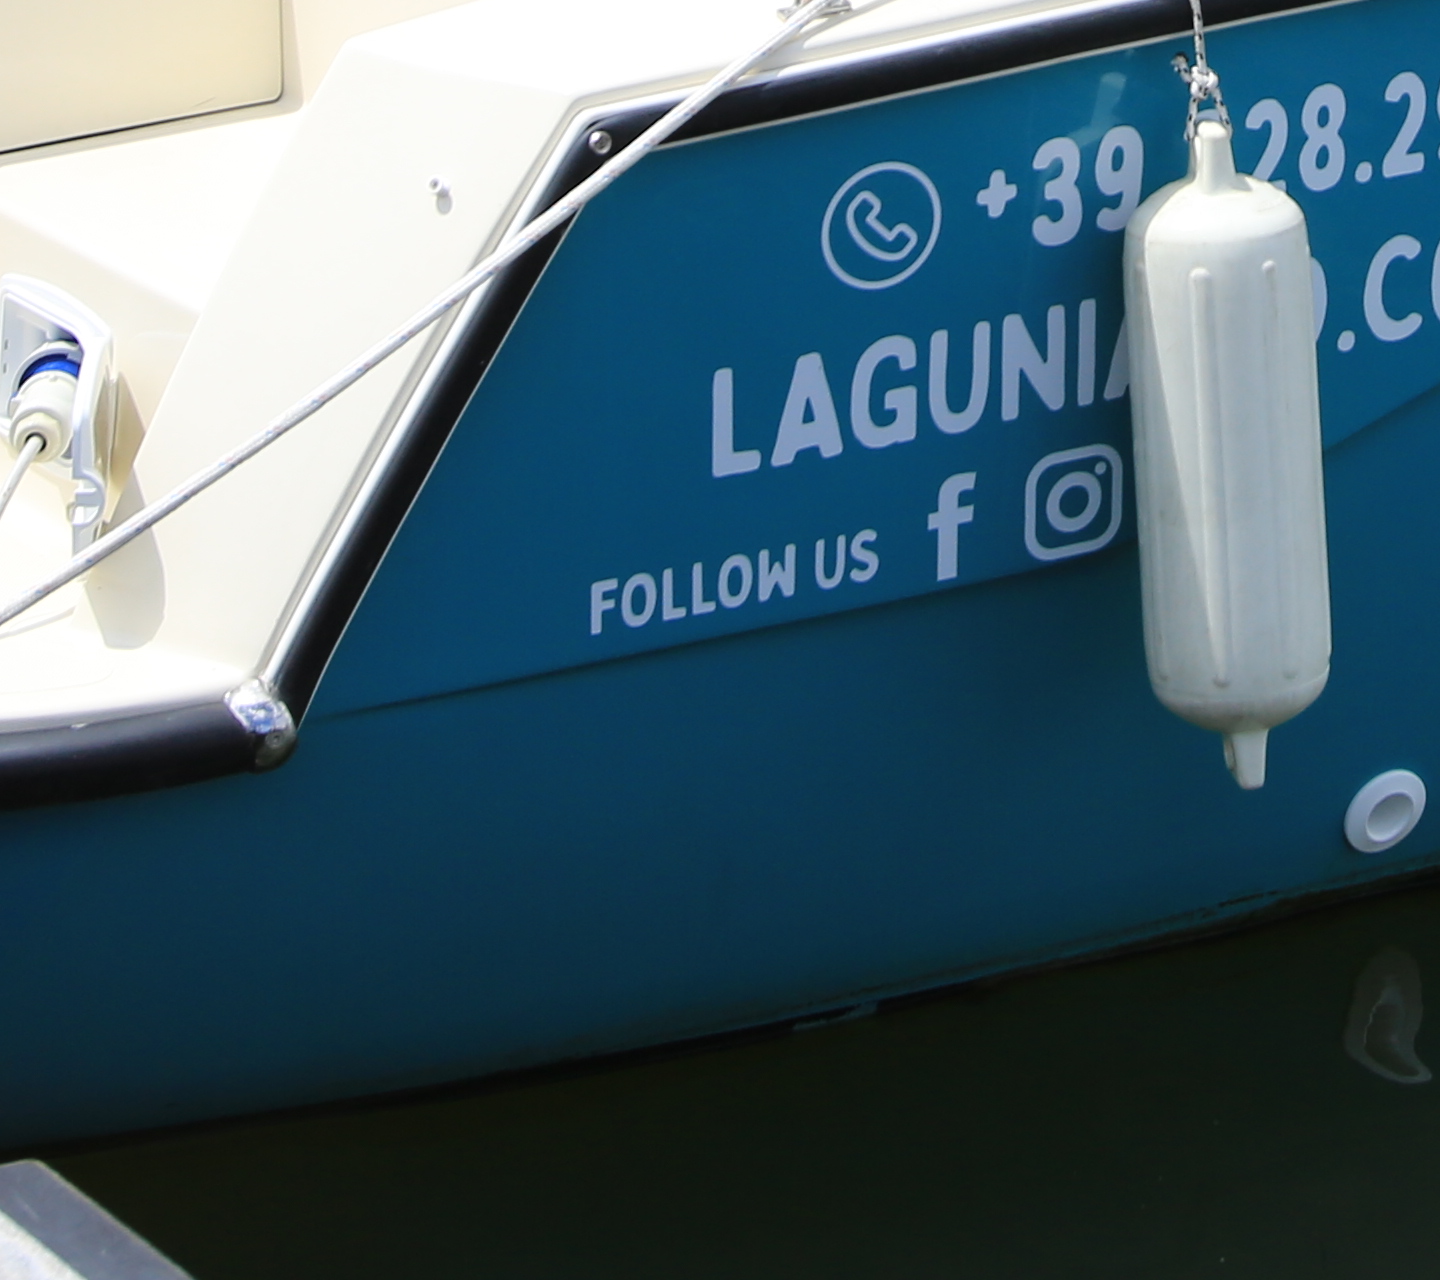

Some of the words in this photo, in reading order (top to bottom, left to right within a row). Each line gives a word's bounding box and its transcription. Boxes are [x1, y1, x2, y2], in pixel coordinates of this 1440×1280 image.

[975, 125, 1145, 248] +39
[590, 535, 796, 635] FOLLOW
[815, 528, 880, 589] US
